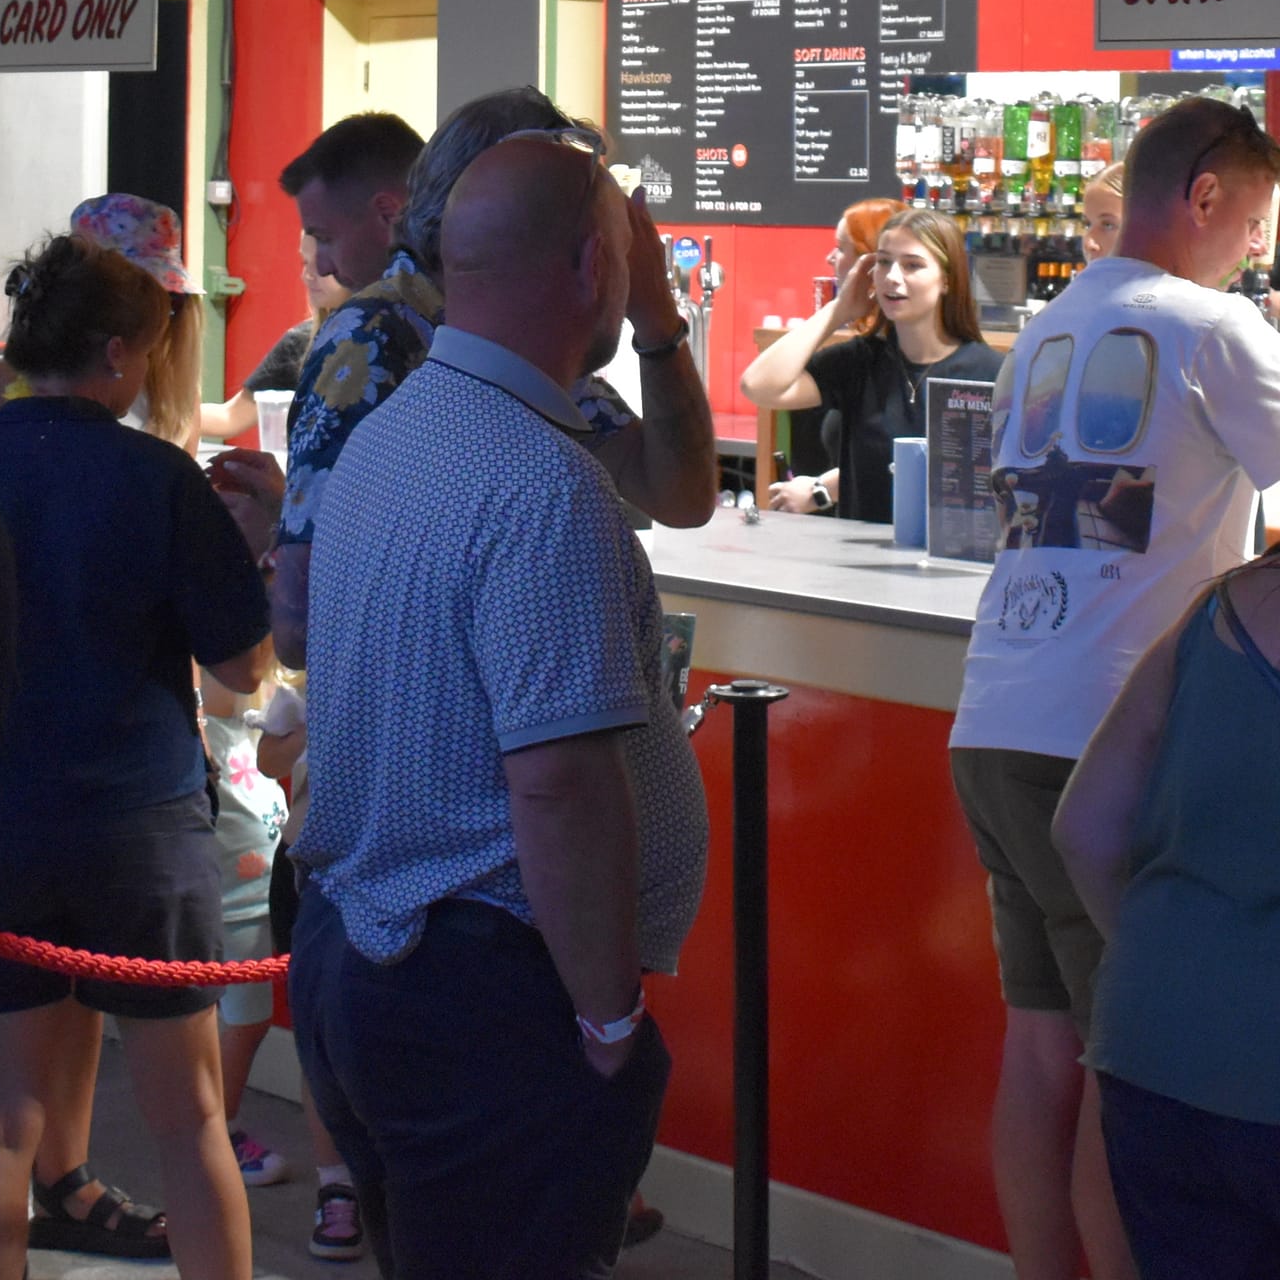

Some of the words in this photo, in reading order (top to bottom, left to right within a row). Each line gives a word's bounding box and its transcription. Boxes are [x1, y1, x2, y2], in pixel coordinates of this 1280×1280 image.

[0, 0, 68, 45] CARD
[794, 47, 822, 62] SOFT
[824, 46, 866, 61] DRINKS
[1179, 50, 1204, 59] when
[1206, 48, 1238, 62] buying
[1239, 47, 1275, 58] alcohol
[621, 72, 672, 85] Hawkstone
[696, 149, 728, 161] SHOTS
[675, 248, 699, 257] CIDER
[948, 398, 967, 410] BAR
